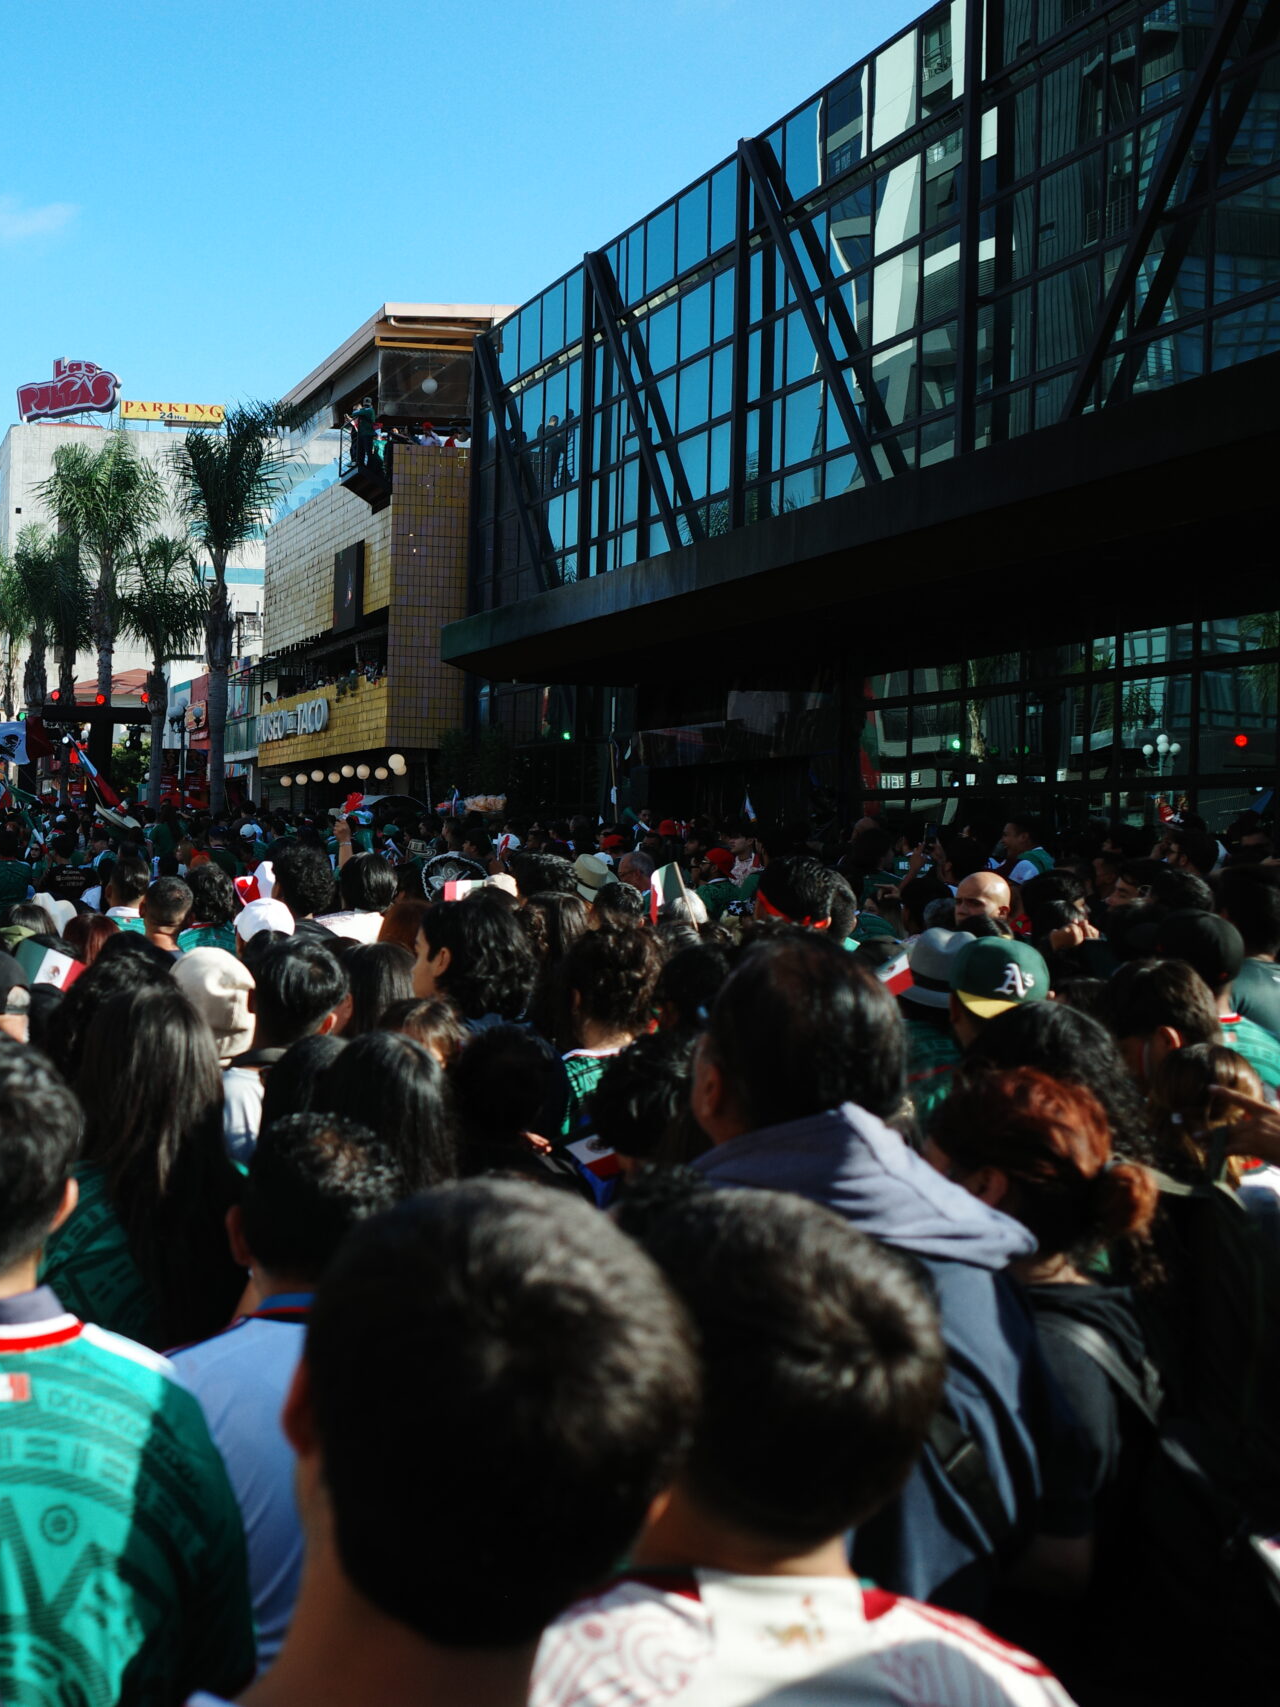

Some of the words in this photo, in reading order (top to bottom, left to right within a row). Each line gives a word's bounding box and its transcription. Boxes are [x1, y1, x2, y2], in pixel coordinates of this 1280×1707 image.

[124, 400, 222, 418] PARKING
[159, 411, 173, 420] 24
[256, 710, 286, 744] MUSEO
[296, 697, 327, 735] TACO
[993, 962, 1035, 999] A's
